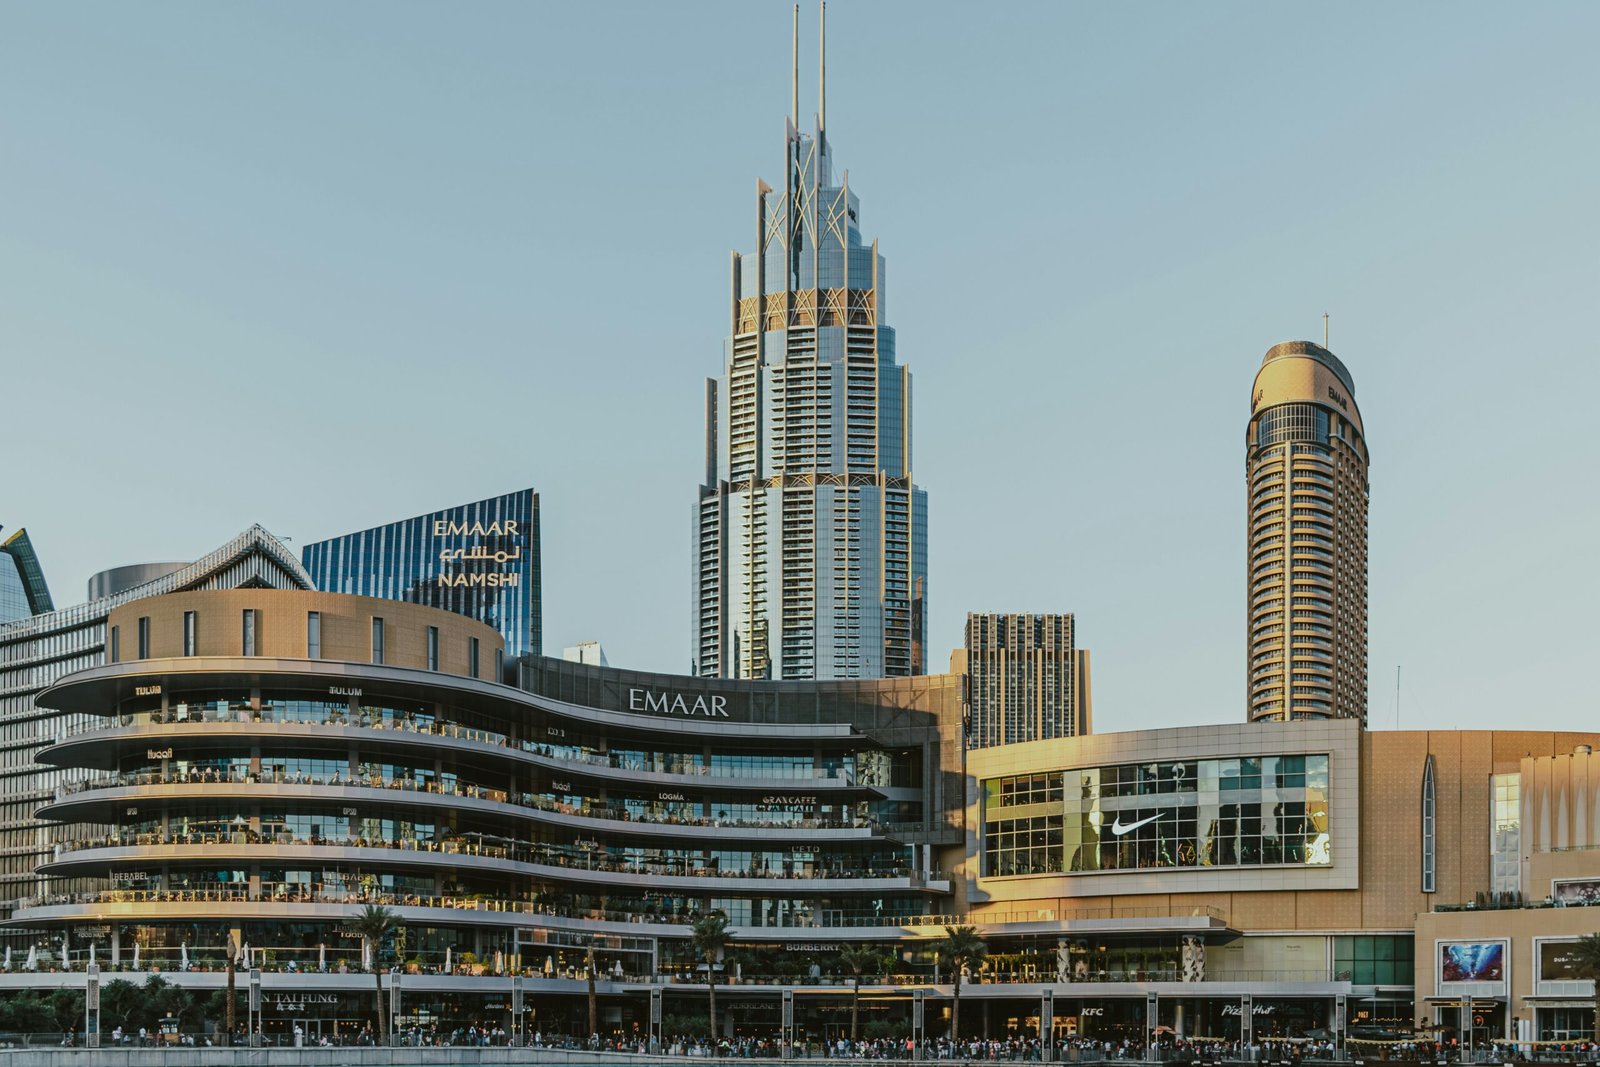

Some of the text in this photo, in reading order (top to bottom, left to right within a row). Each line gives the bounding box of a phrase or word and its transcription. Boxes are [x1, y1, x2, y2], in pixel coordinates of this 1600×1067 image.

[434, 520, 519, 536] EMAAR
[438, 573, 518, 587] NAMSHI
[329, 686, 362, 696] TULUM
[629, 688, 729, 717] EMAAR
[786, 943, 840, 951] BURBERRY
[301, 993, 339, 1004] FUNG
[1080, 1007, 1104, 1016] KFC
[1252, 1004, 1276, 1015] Hut
